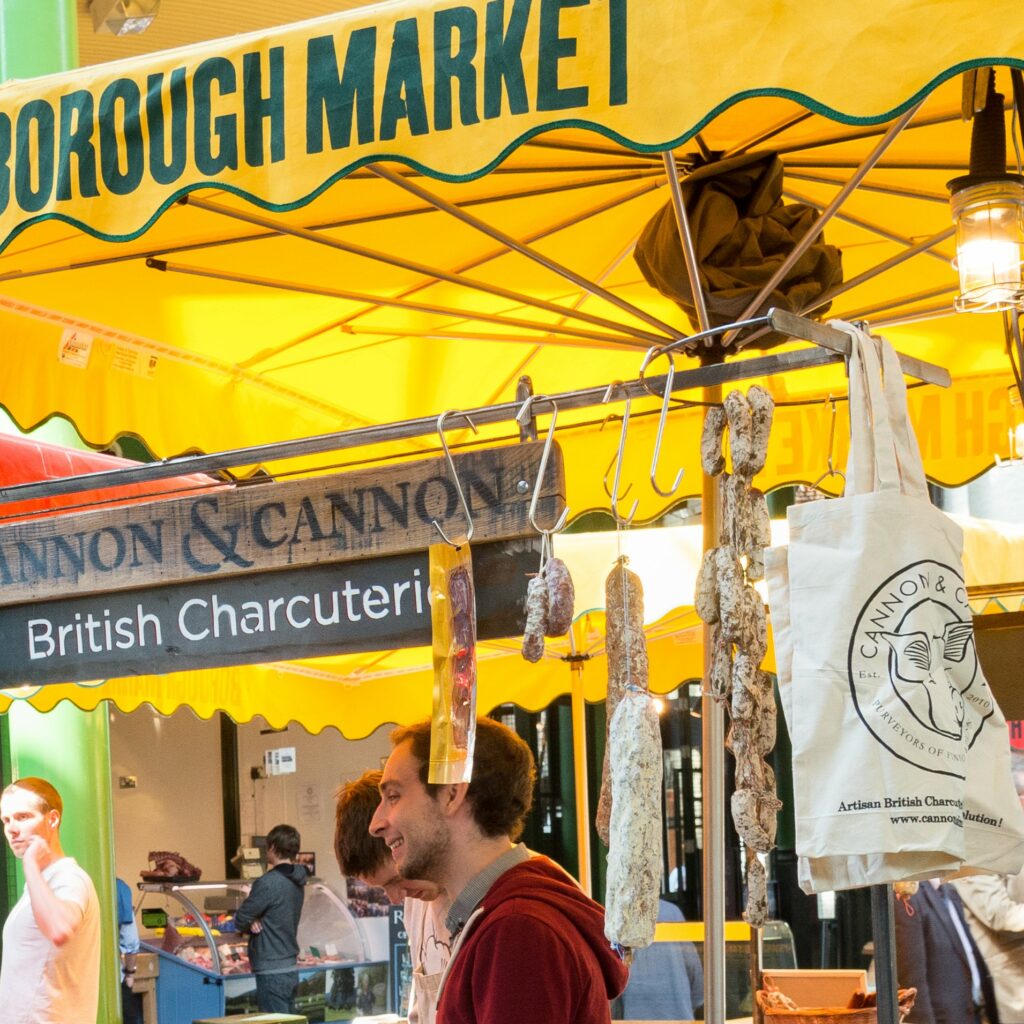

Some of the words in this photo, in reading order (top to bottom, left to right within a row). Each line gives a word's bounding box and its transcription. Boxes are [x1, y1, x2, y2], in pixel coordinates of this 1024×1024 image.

[306, 0, 628, 155] MARKET
[181, 497, 255, 573] &
[251, 464, 504, 545] CANNON
[27, 602, 163, 661] British
[178, 568, 432, 642] Charcuteri
[860, 572, 930, 659] CANNON
[935, 575, 946, 593] &
[859, 670, 881, 679] Est.
[966, 693, 990, 709] 2010
[872, 700, 925, 750] PURVEYORS
[928, 745, 943, 758] OF
[838, 797, 882, 812] Artisan
[884, 796, 922, 809] British
